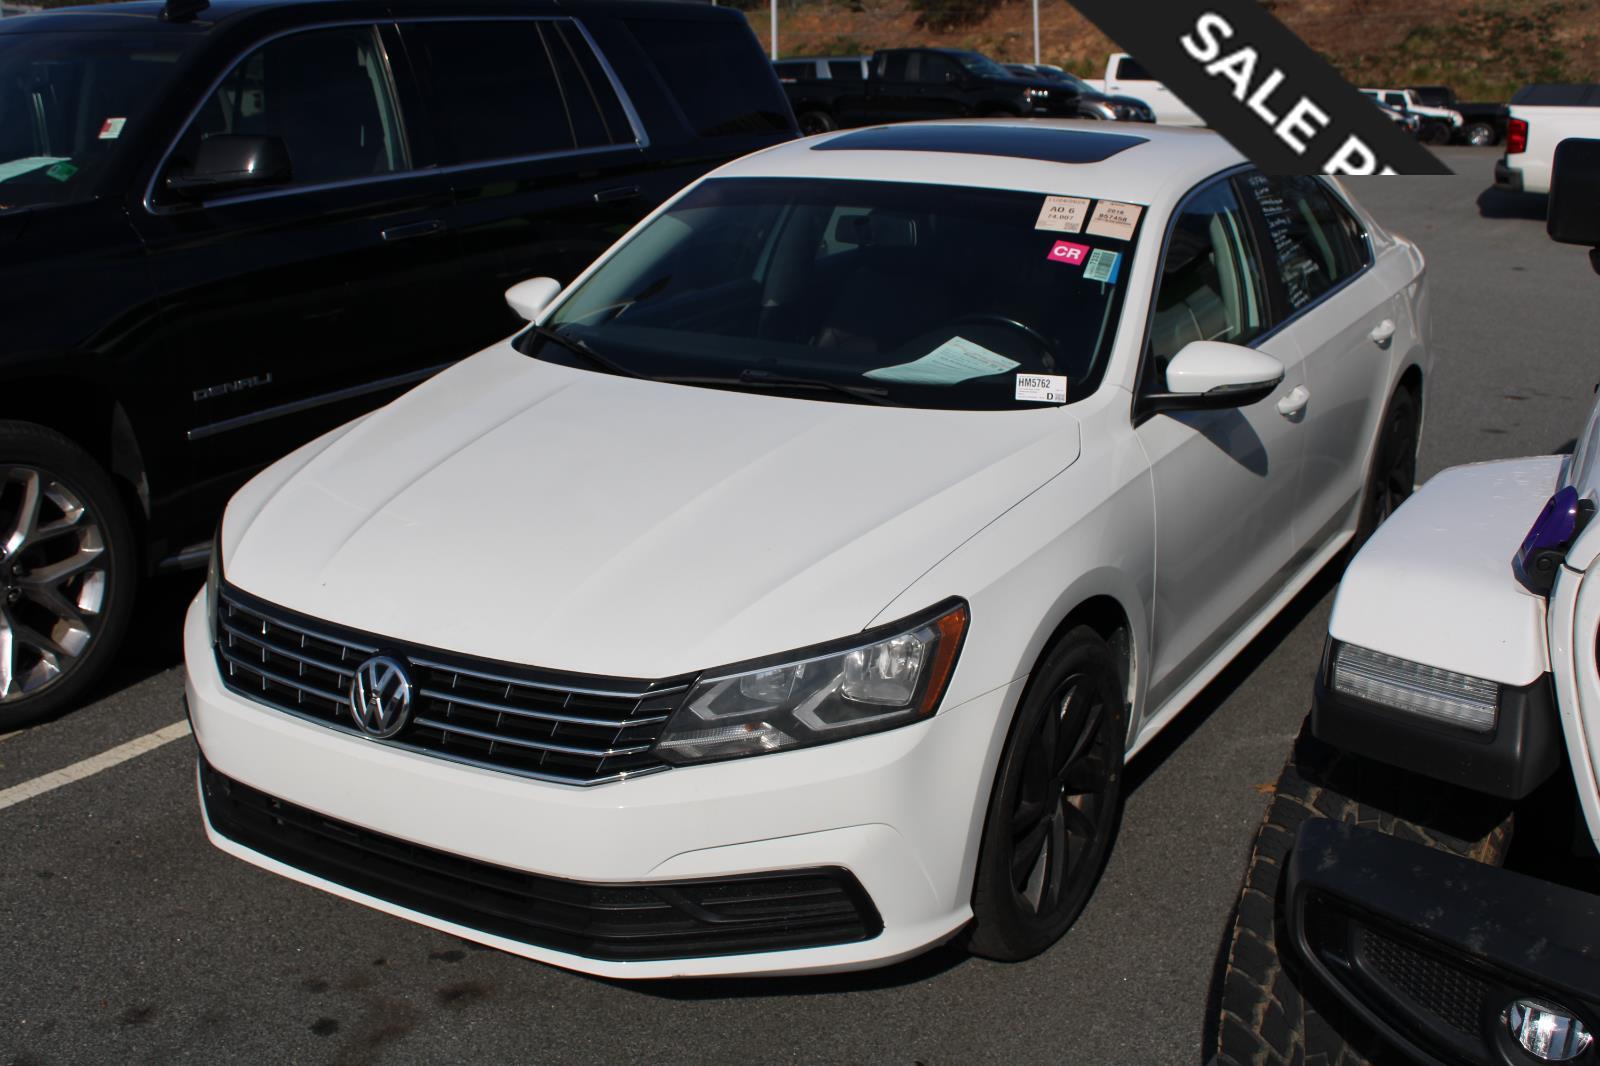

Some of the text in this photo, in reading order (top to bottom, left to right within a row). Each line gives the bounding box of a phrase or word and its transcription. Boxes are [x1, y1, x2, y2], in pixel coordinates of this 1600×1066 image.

[1053, 245, 1082, 260] CR
[192, 371, 272, 401] DENALI
[1018, 377, 1051, 389] HM5762
[1046, 392, 1054, 401] D
